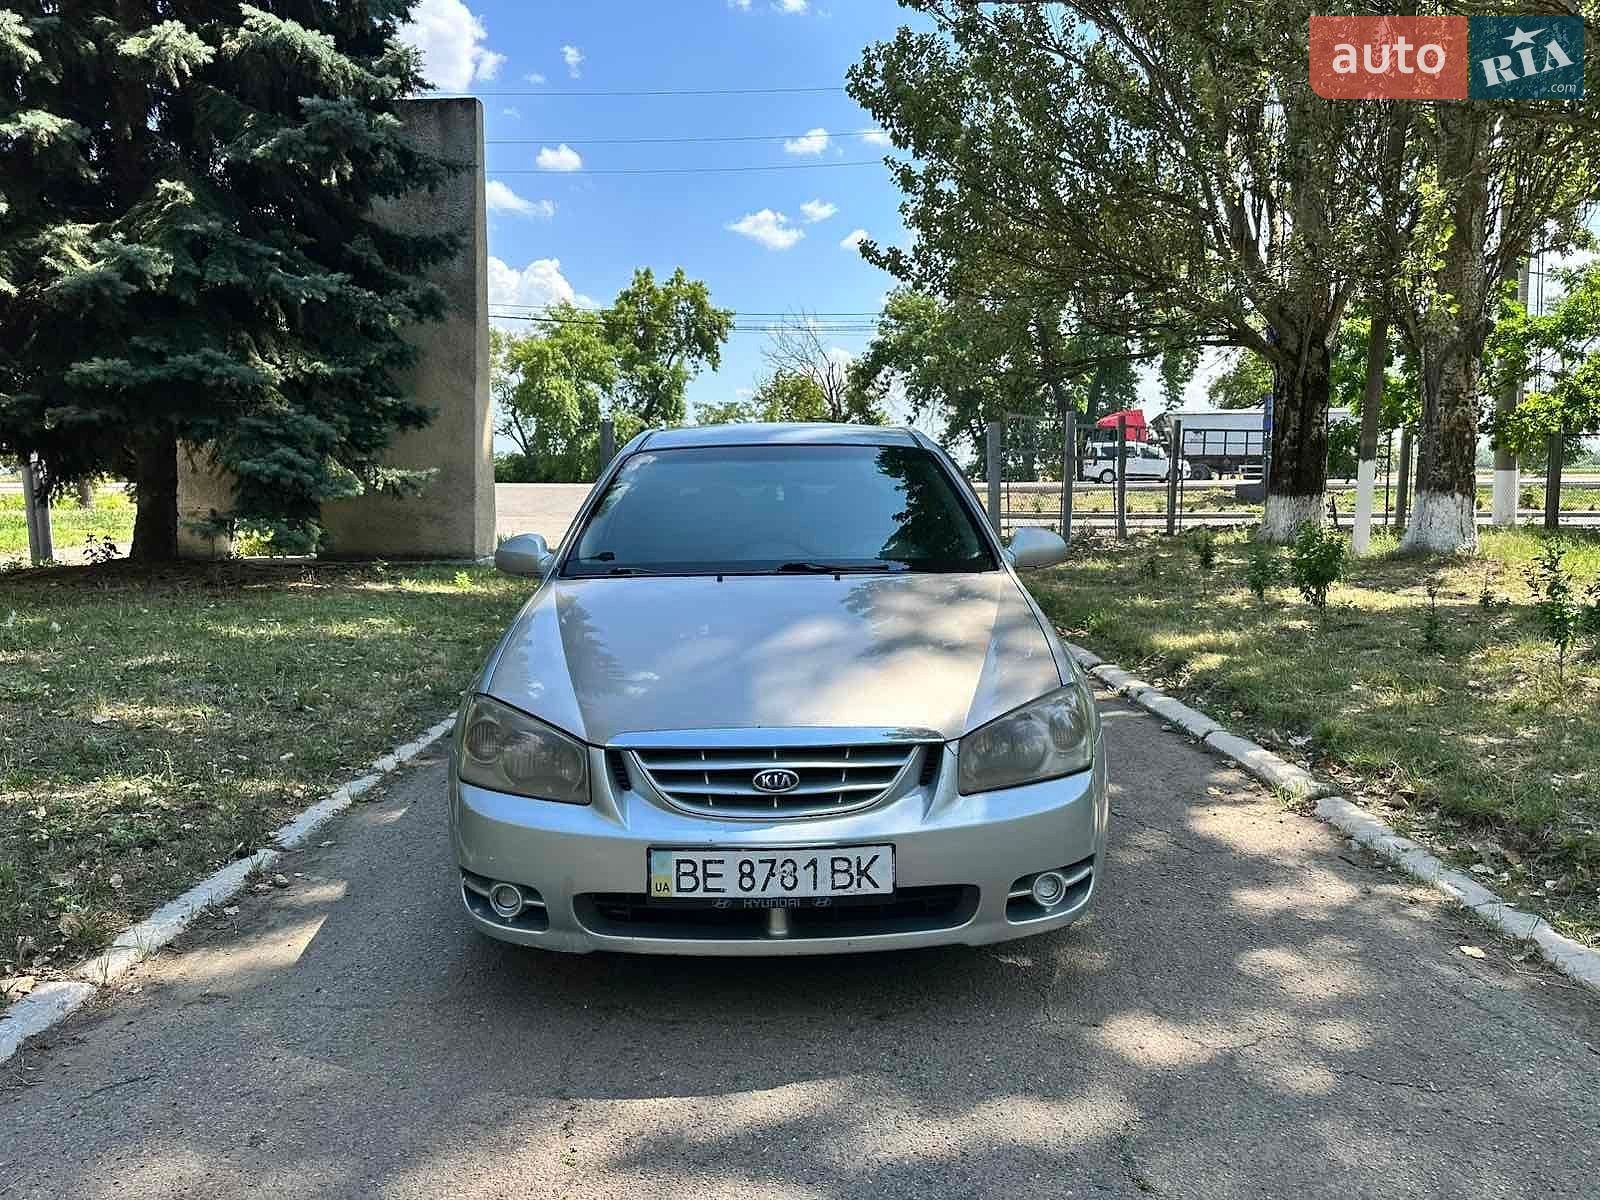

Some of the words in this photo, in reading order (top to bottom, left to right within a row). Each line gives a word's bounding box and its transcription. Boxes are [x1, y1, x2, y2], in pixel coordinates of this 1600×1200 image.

[761, 773, 791, 787] KIA
[675, 858, 725, 893] BE
[830, 854, 880, 890] BK
[655, 882, 670, 892] UA
[743, 899, 800, 909] HYUNDAI
